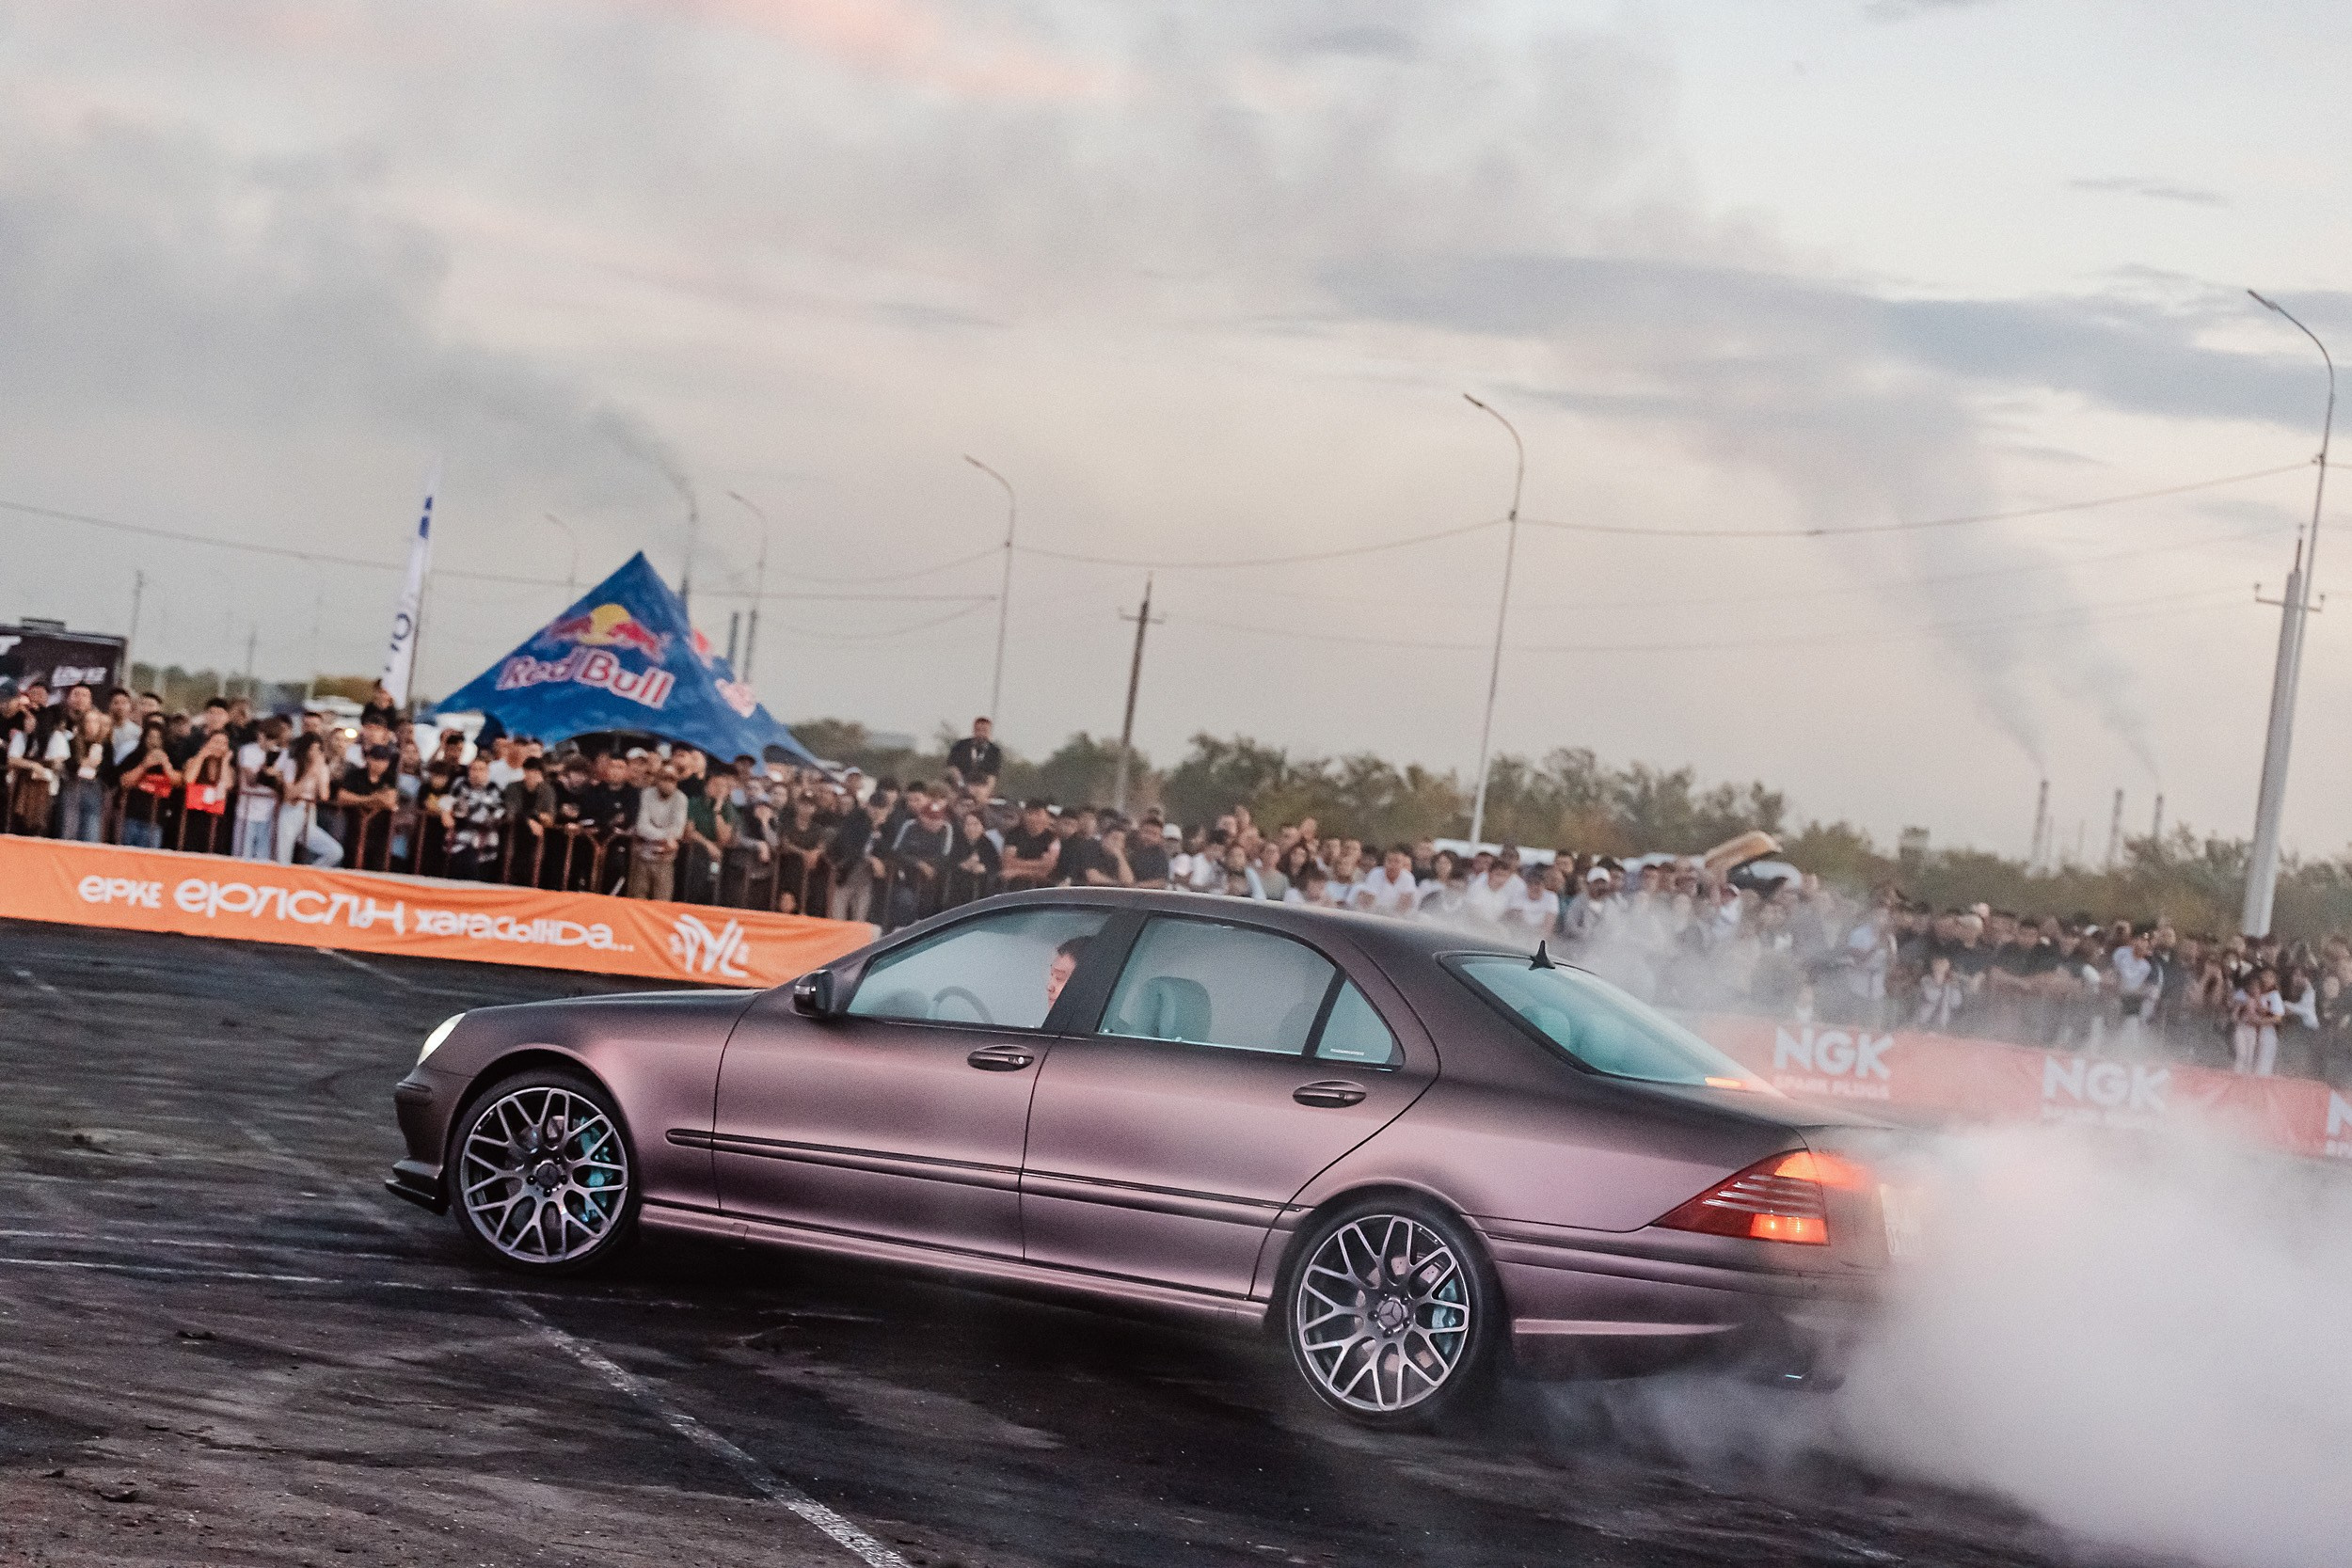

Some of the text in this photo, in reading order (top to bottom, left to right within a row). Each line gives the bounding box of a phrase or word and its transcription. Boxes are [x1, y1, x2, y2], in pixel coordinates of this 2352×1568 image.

[498, 648, 584, 689] Red
[578, 651, 673, 707] Bull
[1774, 1026, 1893, 1080] NGK
[2042, 1055, 2171, 1113] NGK
